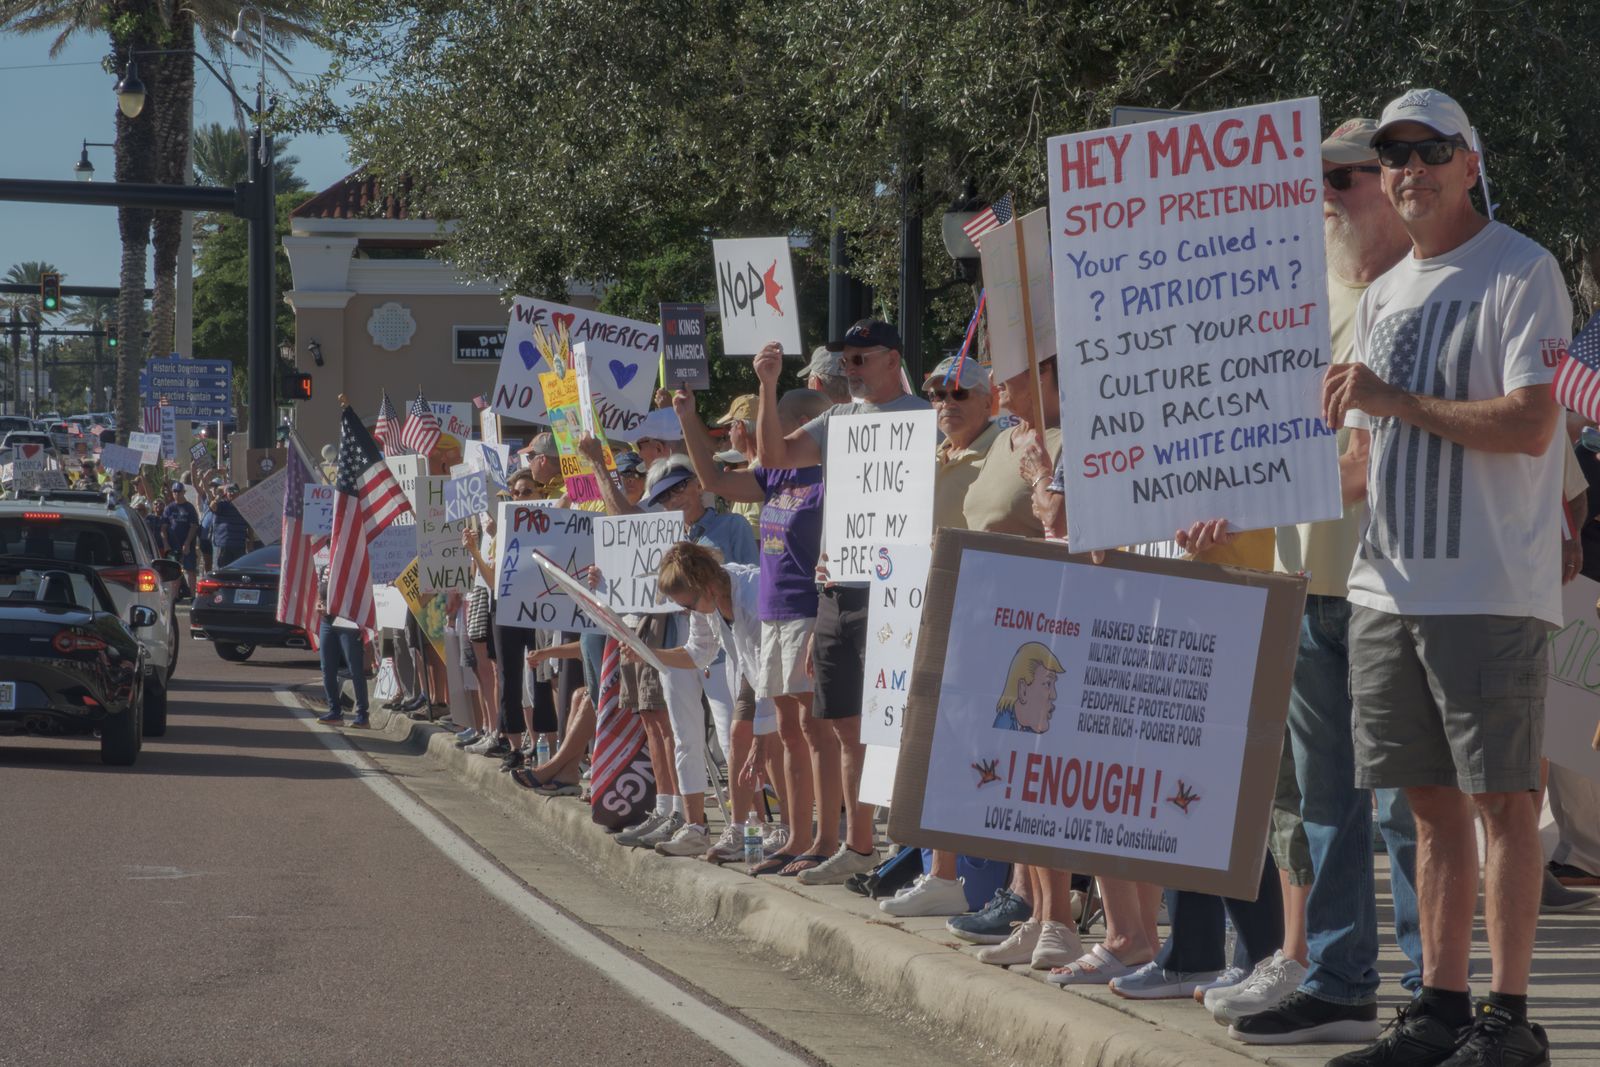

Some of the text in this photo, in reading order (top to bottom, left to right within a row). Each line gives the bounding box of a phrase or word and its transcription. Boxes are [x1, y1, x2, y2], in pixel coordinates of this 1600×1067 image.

[1060, 110, 1305, 192] HEY MAGA!
[1064, 178, 1317, 236] STOP PRETENDING
[1067, 250, 1128, 279] Your
[1121, 265, 1280, 316] PATRIOTISM
[516, 303, 660, 352] WE AMERICA
[666, 319, 700, 336] NO KINGS
[1075, 302, 1317, 365] IS JUST YOUR CULT
[1539, 337, 1568, 347] TEA
[460, 348, 489, 357] TEETH
[675, 344, 705, 359] AMERICA
[153, 364, 208, 374] Historic Downtown
[153, 378, 199, 388] Centennial Park
[1099, 347, 1328, 399] CULTURE CONTROL
[186, 392, 211, 401] Fountain
[303, 379, 311, 396] 4
[496, 383, 533, 409] NO
[175, 406, 192, 415] Beach
[432, 403, 452, 414] THE
[1091, 388, 1270, 440] AND RACISM
[848, 422, 915, 454] NOT MY
[1083, 446, 1145, 479] STOP
[1153, 430, 1225, 466] WHITE
[456, 477, 482, 500] NO
[1132, 457, 1292, 504] NATIONALISM
[445, 491, 489, 523] KINGS
[846, 512, 908, 539] NOT MY
[442, 547, 458, 558] OF
[517, 601, 556, 623] NO
[994, 607, 1081, 637] FELON Creates
[1091, 618, 1217, 653] MASKED SECRET POLICE
[1088, 642, 1213, 678] MILITARY OCCUPATION OF US CITIES
[1083, 666, 1209, 702] KIDNAPPING AMERICAN CITIZENS
[1081, 689, 1206, 723] PEDOPHILE PROTECTIONS
[1077, 712, 1112, 735] RICHER
[1112, 718, 1133, 738] RICH
[1139, 721, 1176, 744] POORER
[1177, 726, 1202, 748] POOR
[1022, 752, 1146, 817] ENOUGH
[984, 806, 1012, 830] LOVE
[1013, 813, 1057, 838] America
[1064, 816, 1093, 842] LOVE
[1095, 820, 1113, 845] The
[1116, 823, 1178, 854] Constitution
